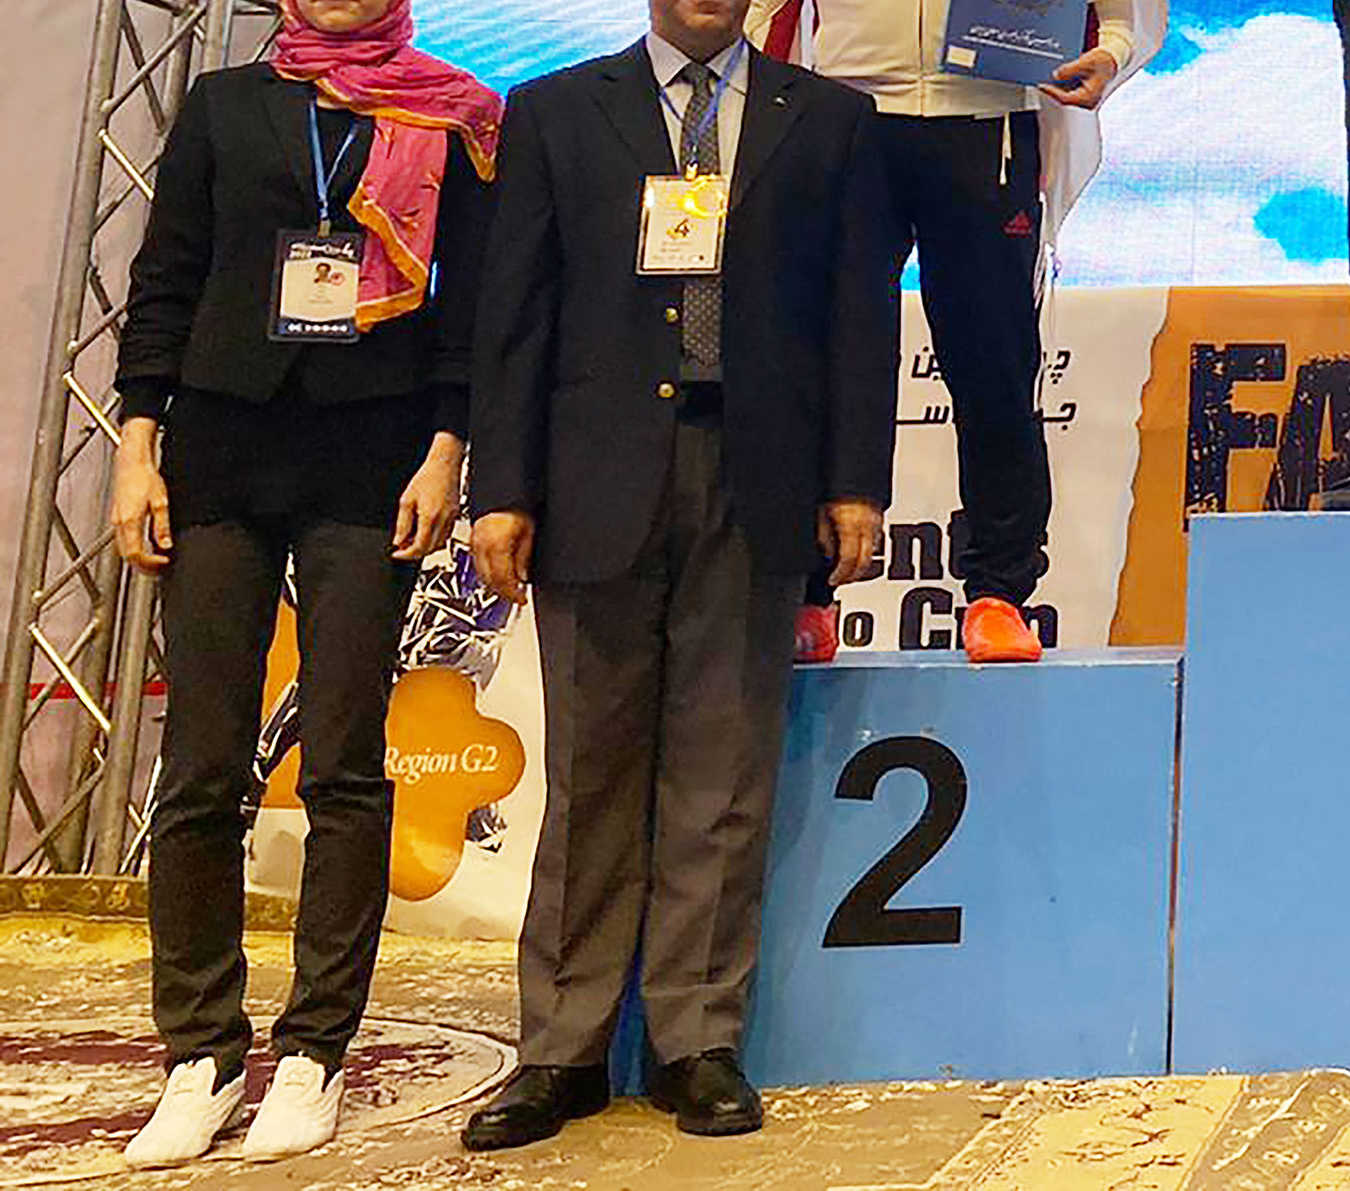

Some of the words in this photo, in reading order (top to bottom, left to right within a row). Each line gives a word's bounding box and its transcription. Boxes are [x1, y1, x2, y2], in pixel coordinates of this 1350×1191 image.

[385, 746, 456, 784] Region
[460, 744, 498, 774] G2
[822, 735, 968, 949] 2
